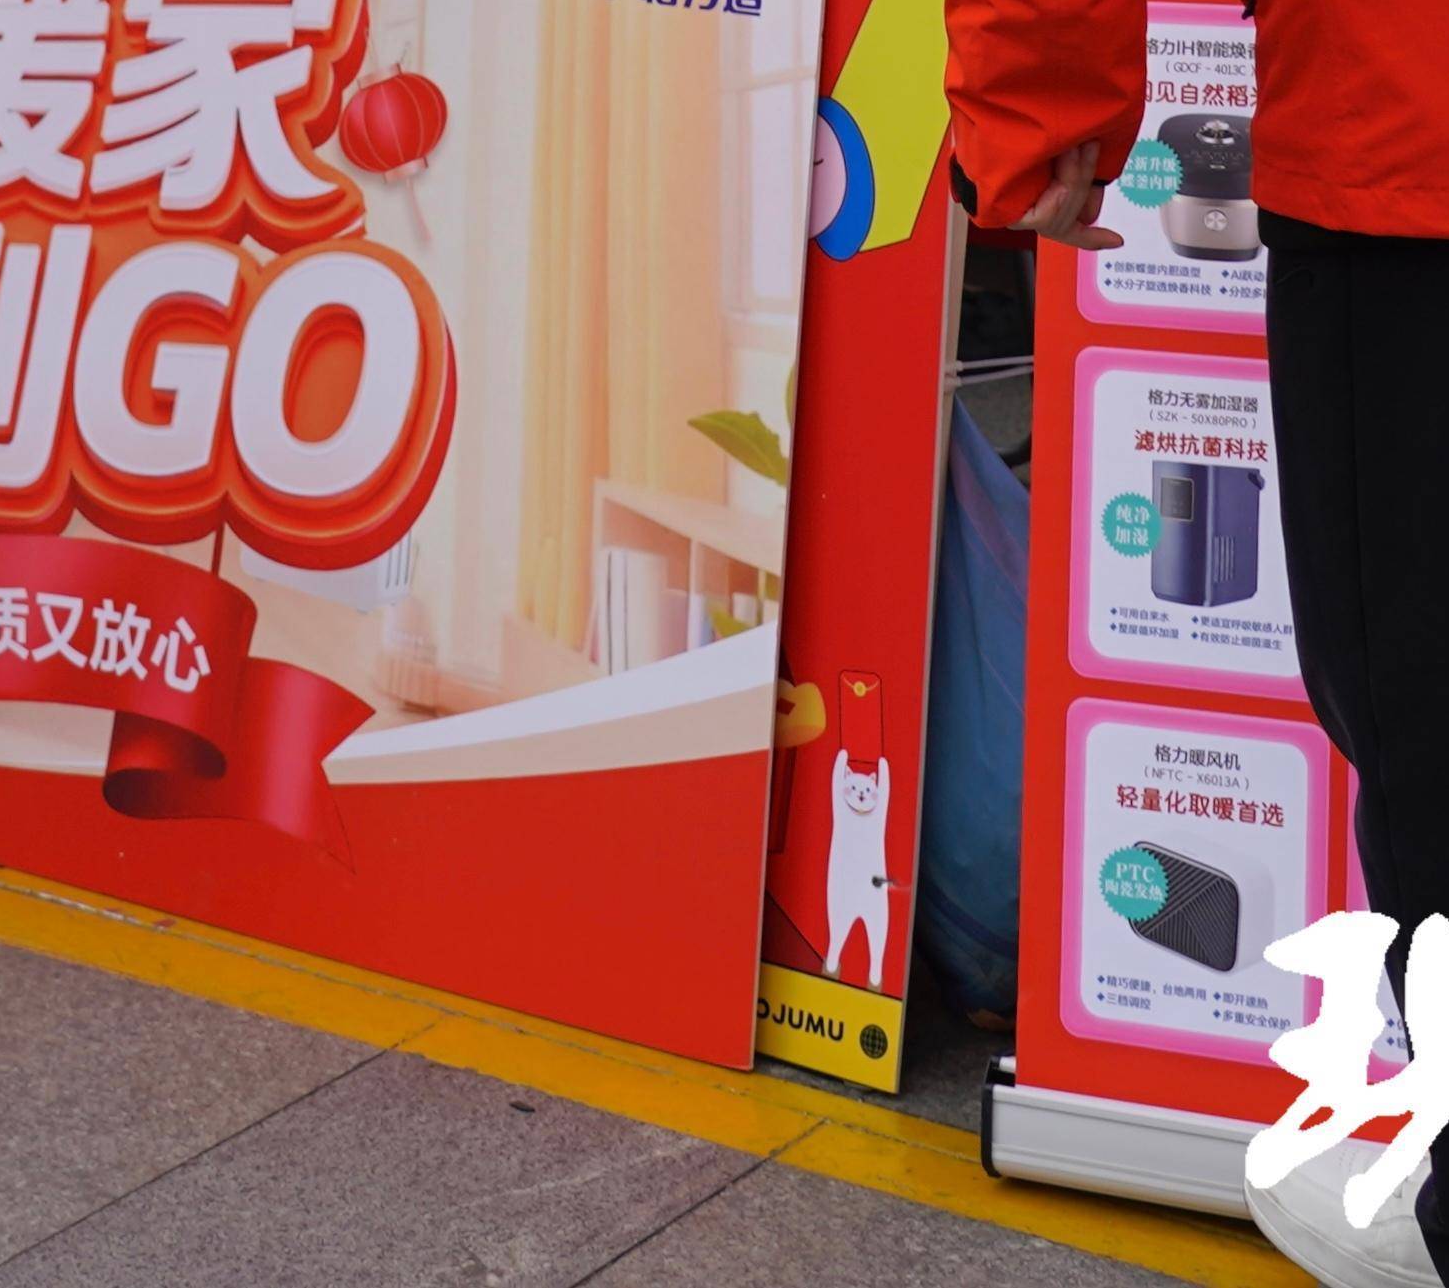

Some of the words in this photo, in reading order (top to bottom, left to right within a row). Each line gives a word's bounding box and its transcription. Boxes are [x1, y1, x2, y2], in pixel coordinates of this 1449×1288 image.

[1147, 387, 1259, 416] 格力无雾加湿器
[1134, 429, 1269, 463] 滤烘抗菌科技
[1154, 742, 1242, 772] 格力暖风机
[1115, 783, 1286, 830] 轻量化取暖首选
[1114, 860, 1156, 882] PTC
